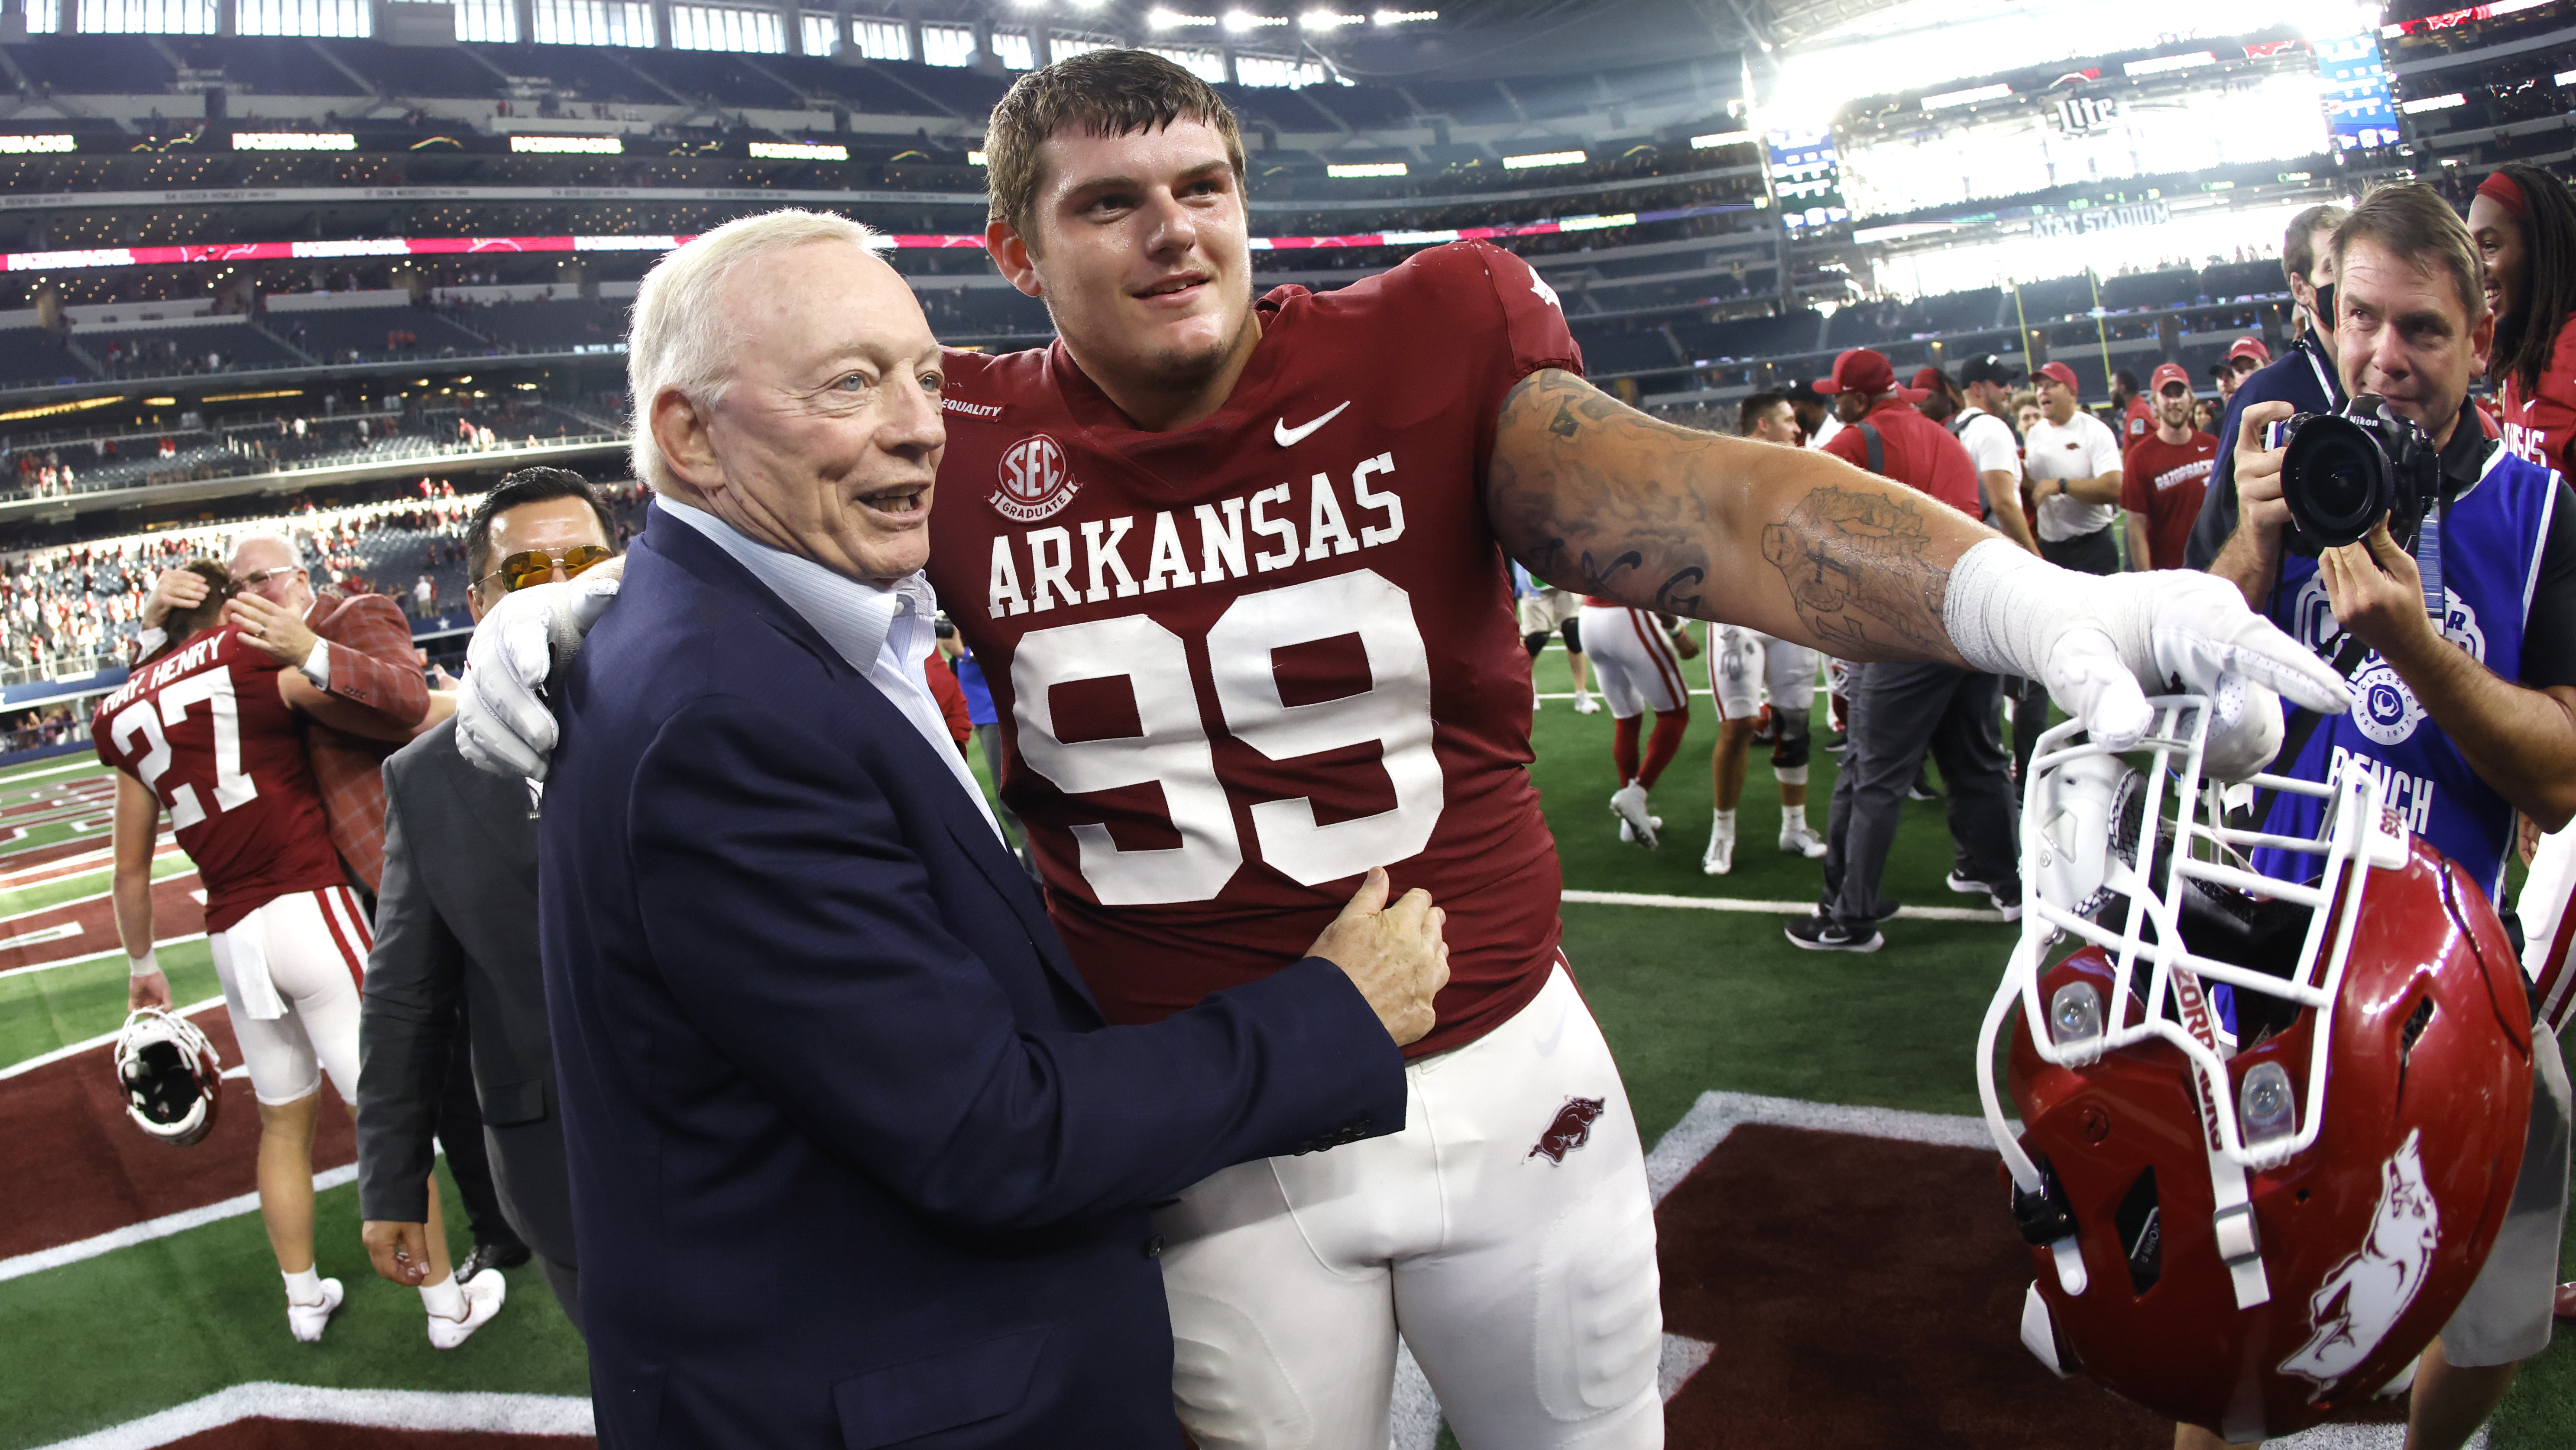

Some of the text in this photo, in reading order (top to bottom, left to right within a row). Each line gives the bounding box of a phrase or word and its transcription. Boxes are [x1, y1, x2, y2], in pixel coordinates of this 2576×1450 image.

[2054, 97, 2113, 134] Lite
[2032, 204, 2171, 239] AT&T STADIUM
[943, 398, 1002, 417] EQUALITY
[2349, 415, 2378, 427] Nikon
[1005, 440, 1060, 497] SEC
[1003, 494, 1066, 519] GRADUATE
[988, 452, 1406, 619] ARKANSAS
[150, 631, 227, 689] HENRY
[2361, 673, 2412, 702] CLASSIC
[1011, 568, 1445, 906] 99
[2386, 719, 2410, 737] 1937
[111, 665, 259, 832] 27
